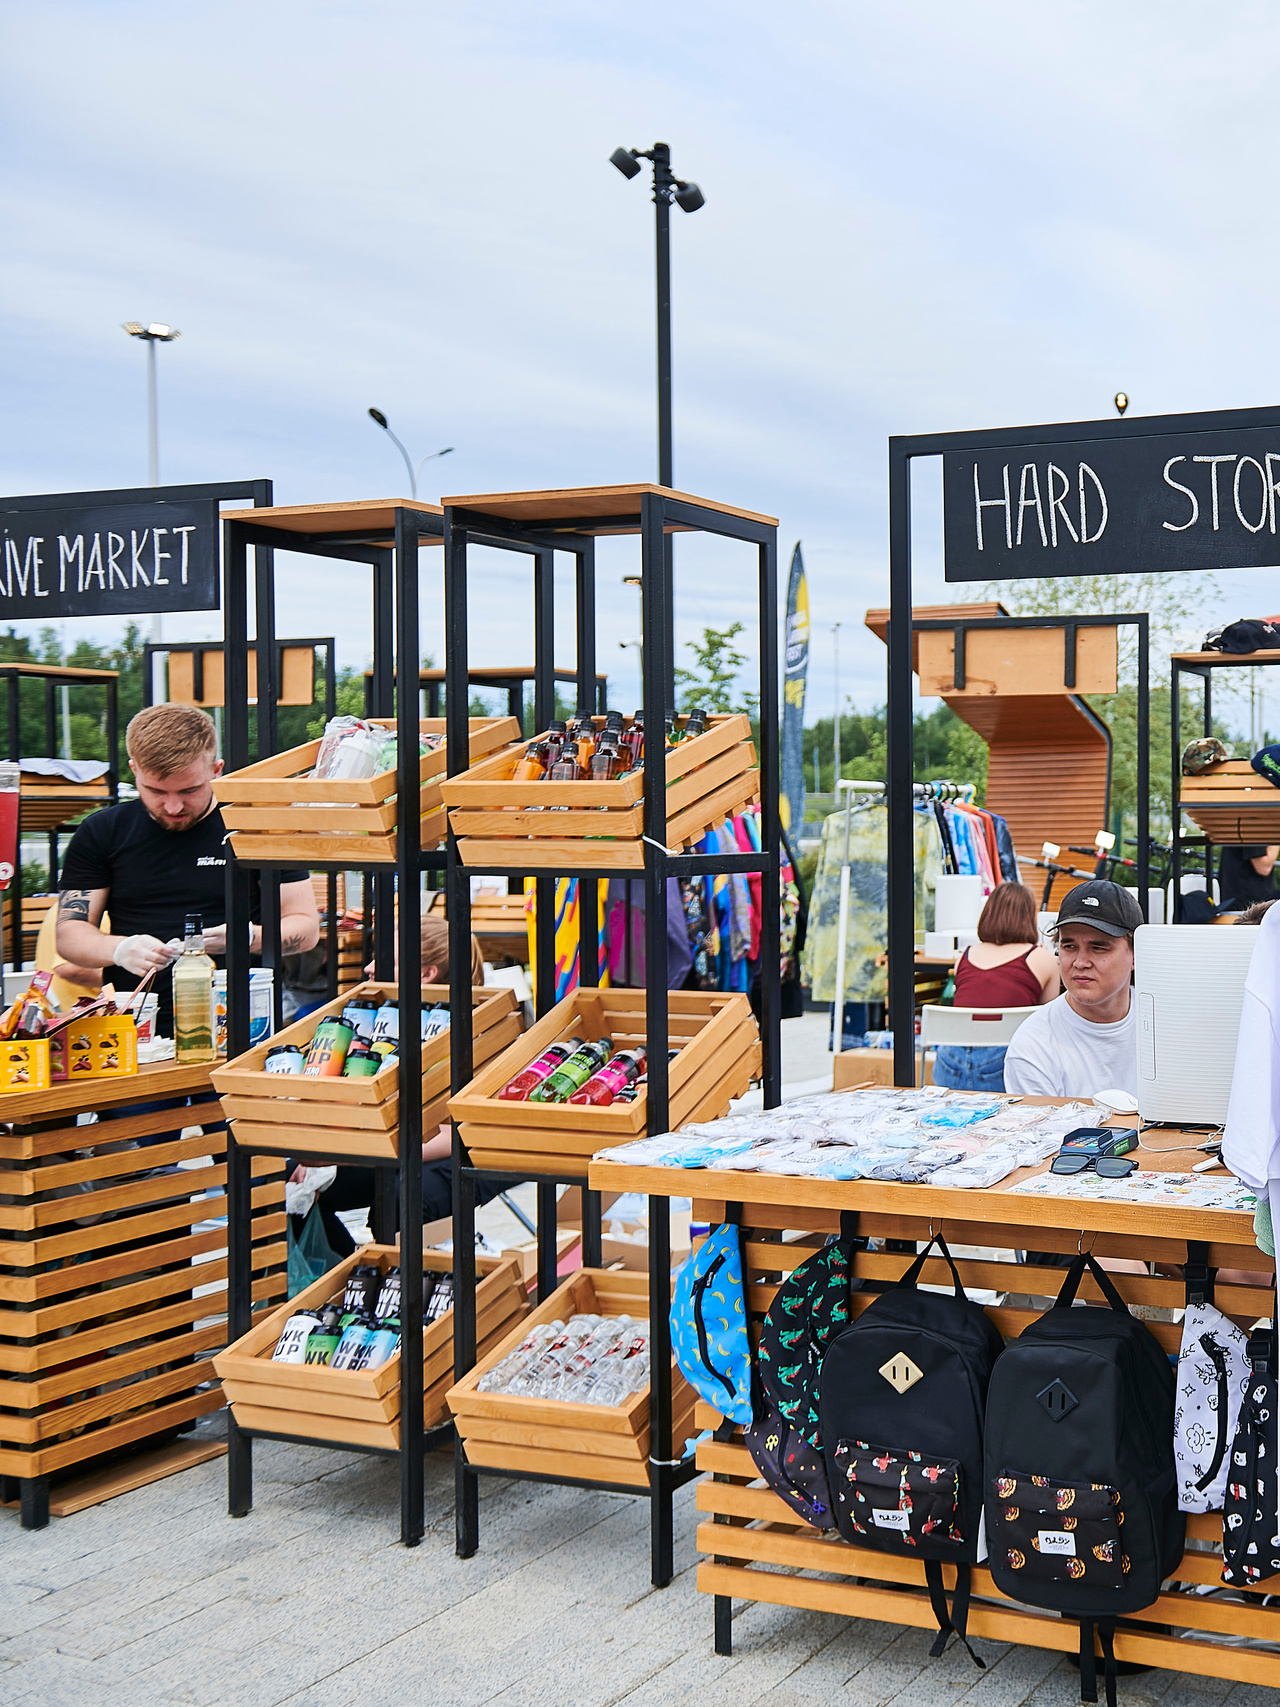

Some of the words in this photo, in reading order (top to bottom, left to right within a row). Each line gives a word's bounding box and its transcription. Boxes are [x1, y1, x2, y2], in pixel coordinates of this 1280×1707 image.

[973, 461, 1109, 551] HARD
[56, 526, 197, 593] MARKET
[311, 1037, 336, 1051] WK
[280, 1330, 304, 1342] WK
[305, 1351, 329, 1365] WK
